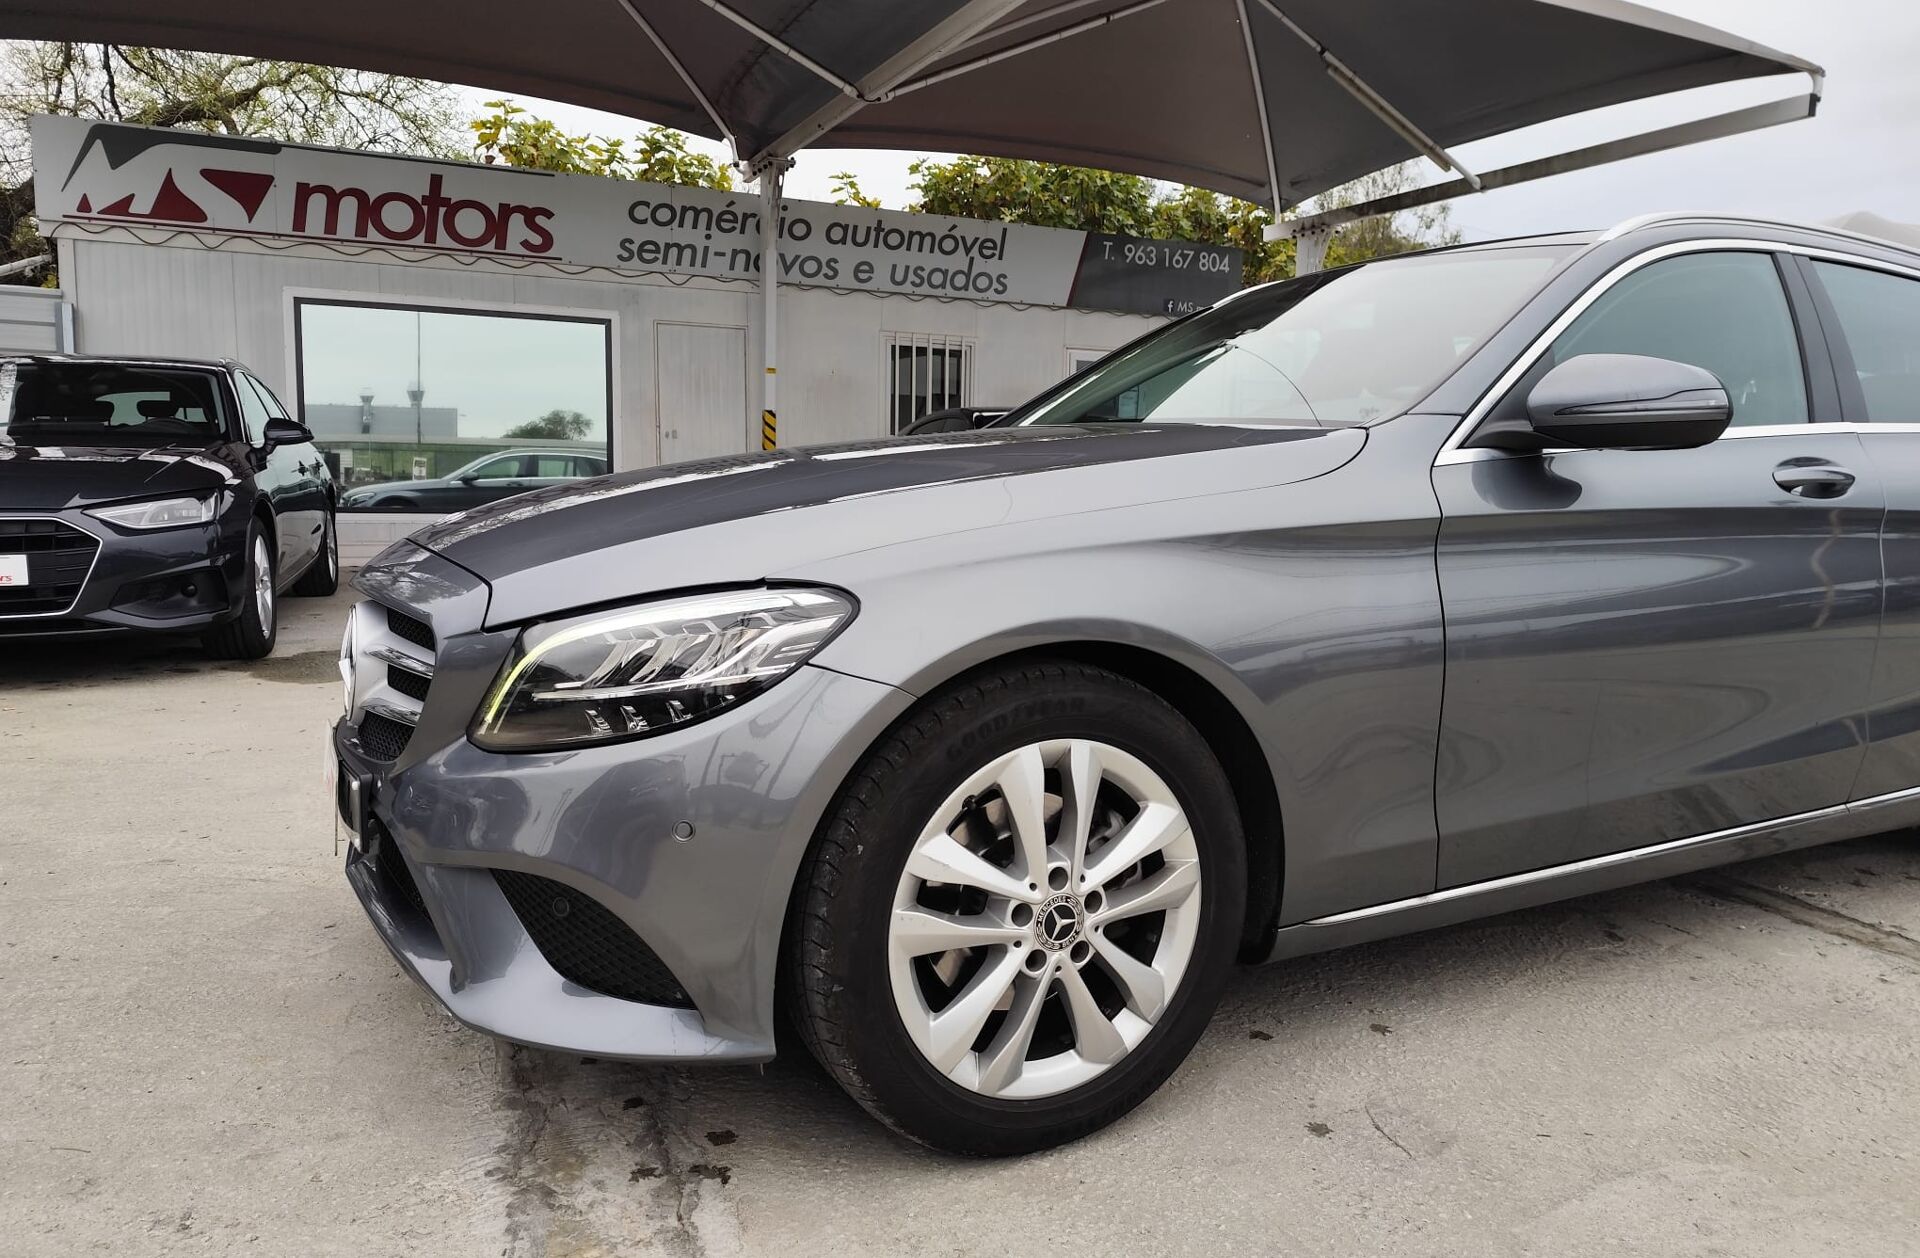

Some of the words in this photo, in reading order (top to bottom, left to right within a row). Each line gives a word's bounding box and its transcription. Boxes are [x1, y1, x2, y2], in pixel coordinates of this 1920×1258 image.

[291, 173, 556, 254] motors
[628, 199, 812, 241] comério
[825, 219, 1008, 261] automóvel
[853, 260, 875, 284] e
[890, 256, 1009, 295] usados
[1103, 241, 1116, 261] T.
[1124, 243, 1157, 267] 963
[1162, 247, 1195, 269] 167
[1199, 251, 1230, 274] 804
[1177, 300, 1194, 313] MS
